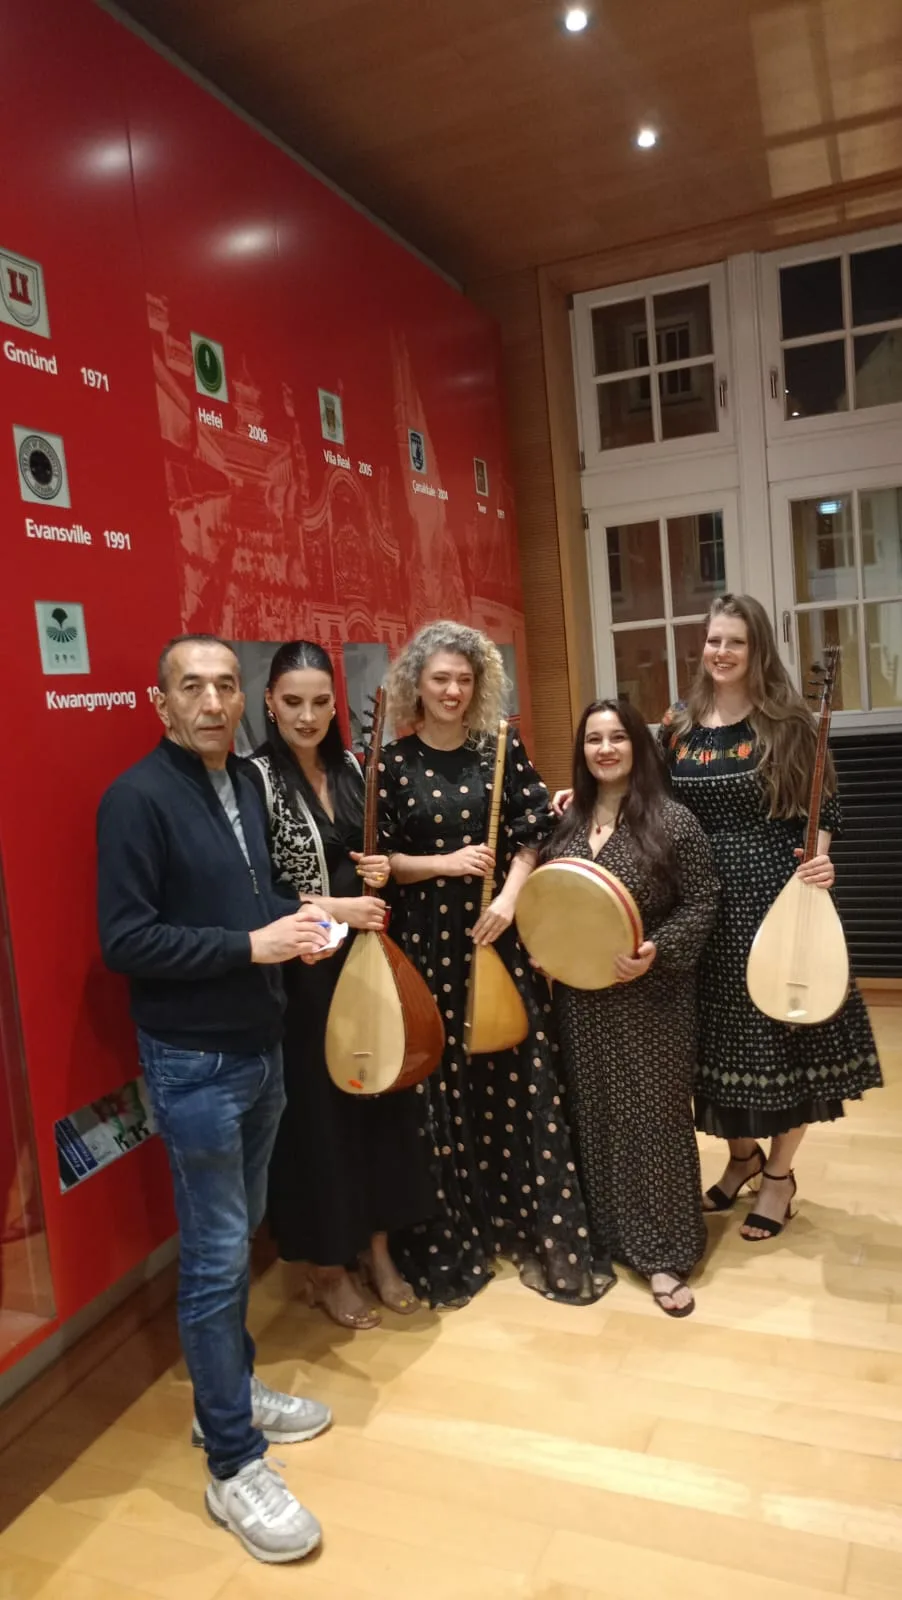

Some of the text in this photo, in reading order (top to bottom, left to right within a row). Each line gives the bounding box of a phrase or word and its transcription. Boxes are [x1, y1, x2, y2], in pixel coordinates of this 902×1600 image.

[3, 341, 110, 392] Gmünd 1971
[198, 407, 268, 443] Hefei 2006
[25, 518, 131, 550] Evansville 1991
[46, 686, 160, 712] Kwangmyong 19
